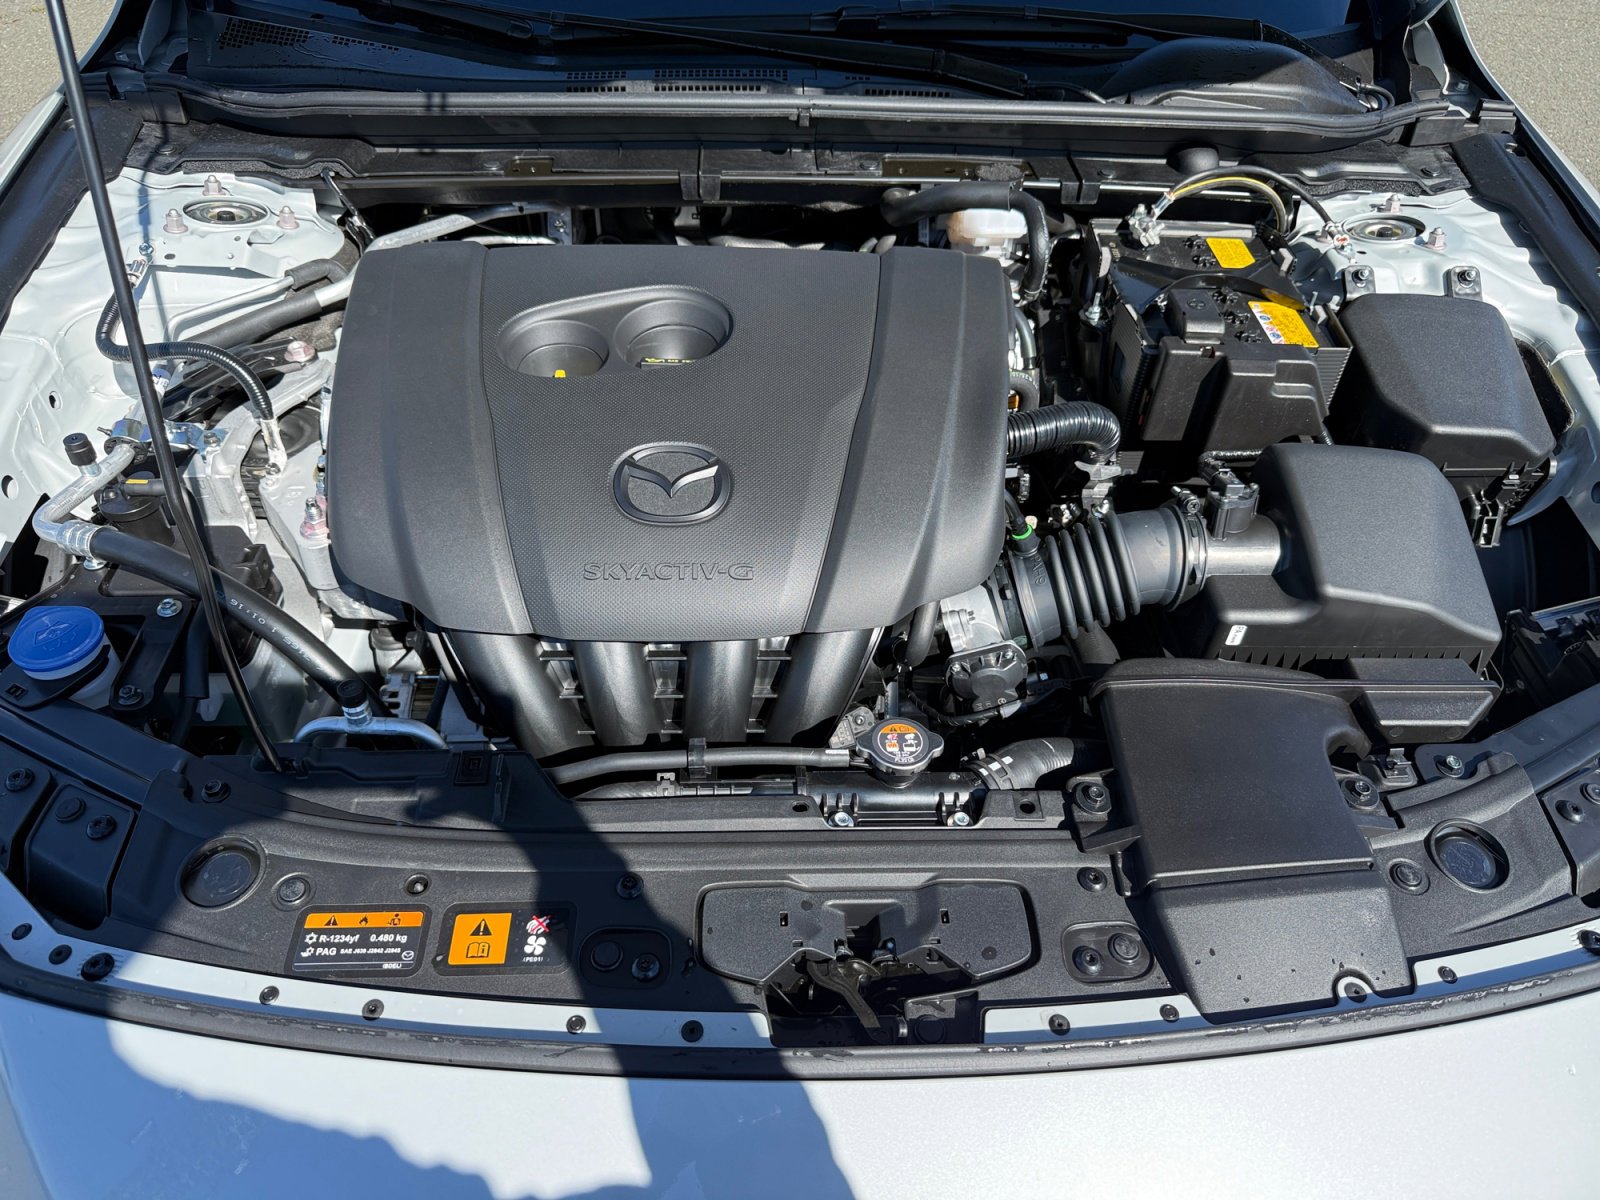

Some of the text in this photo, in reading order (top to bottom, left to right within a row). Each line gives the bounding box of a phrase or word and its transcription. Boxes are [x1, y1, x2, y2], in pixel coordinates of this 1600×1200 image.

[583, 562, 754, 581] SKYACTIV-G
[319, 933, 408, 944] R-1234yf 0.480 kg
[315, 947, 337, 956] PAG
